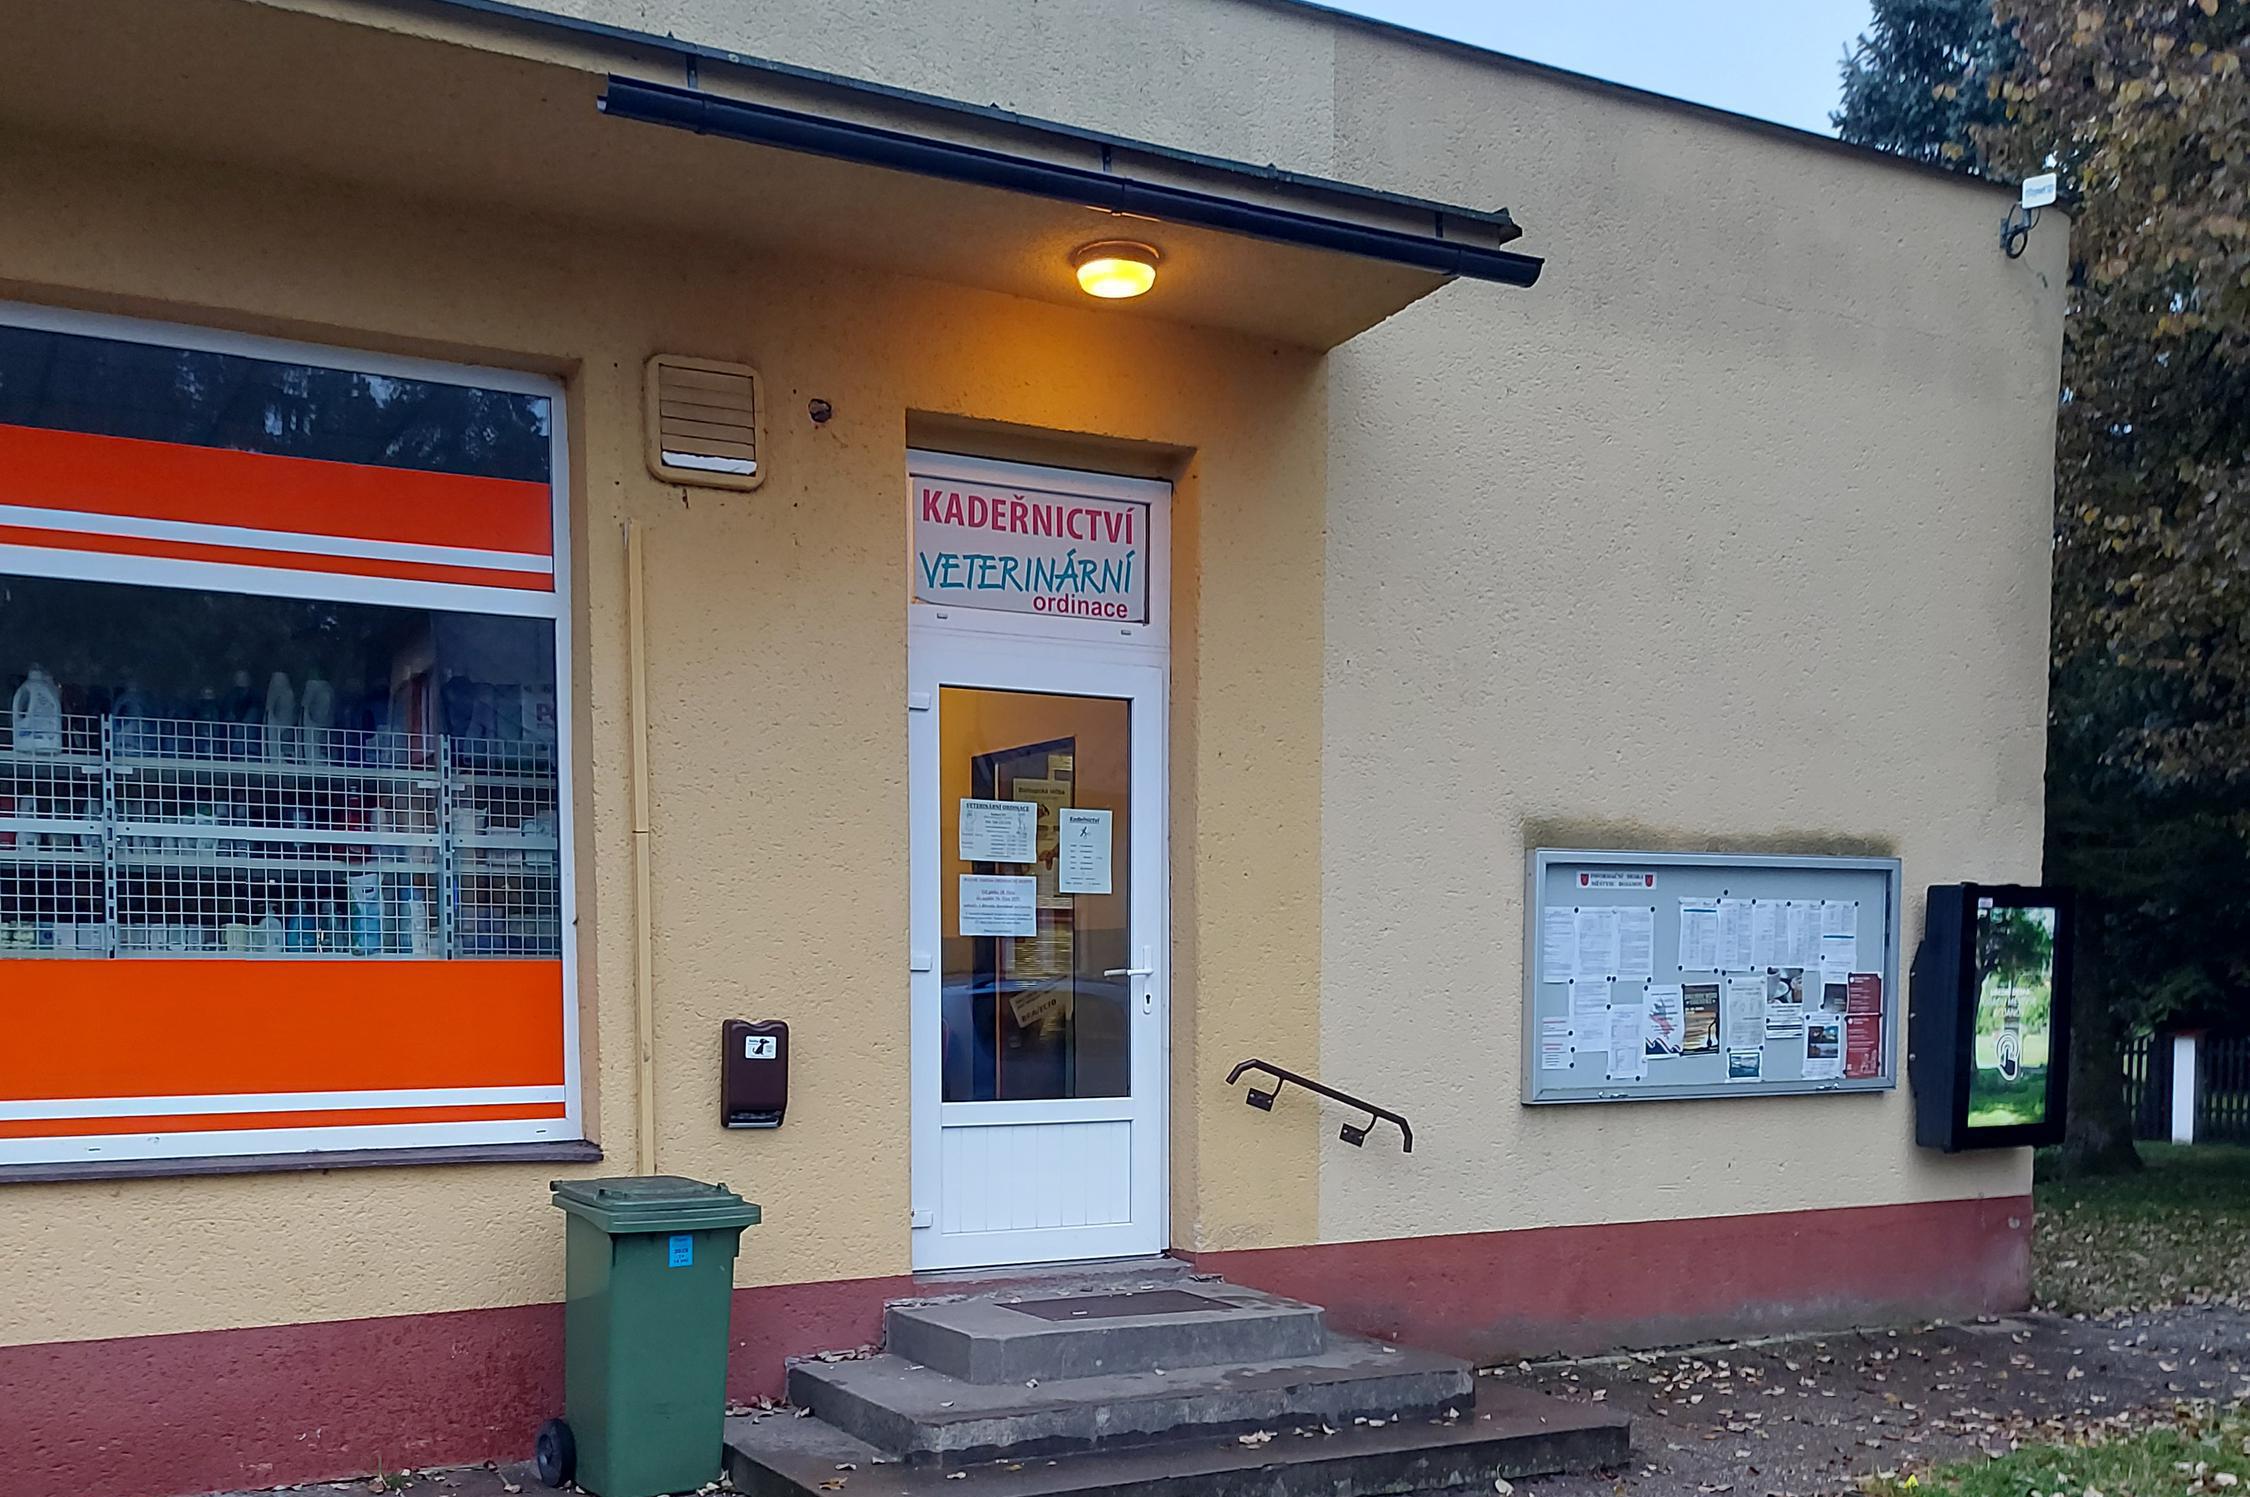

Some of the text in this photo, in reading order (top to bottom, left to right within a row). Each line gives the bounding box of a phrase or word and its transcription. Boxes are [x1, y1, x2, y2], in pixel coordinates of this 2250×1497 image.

[922, 488, 1135, 545] KADEŘNICTVÍ
[919, 547, 1136, 593] VETERINÁRNÍ
[1033, 594, 1128, 618] ordinace
